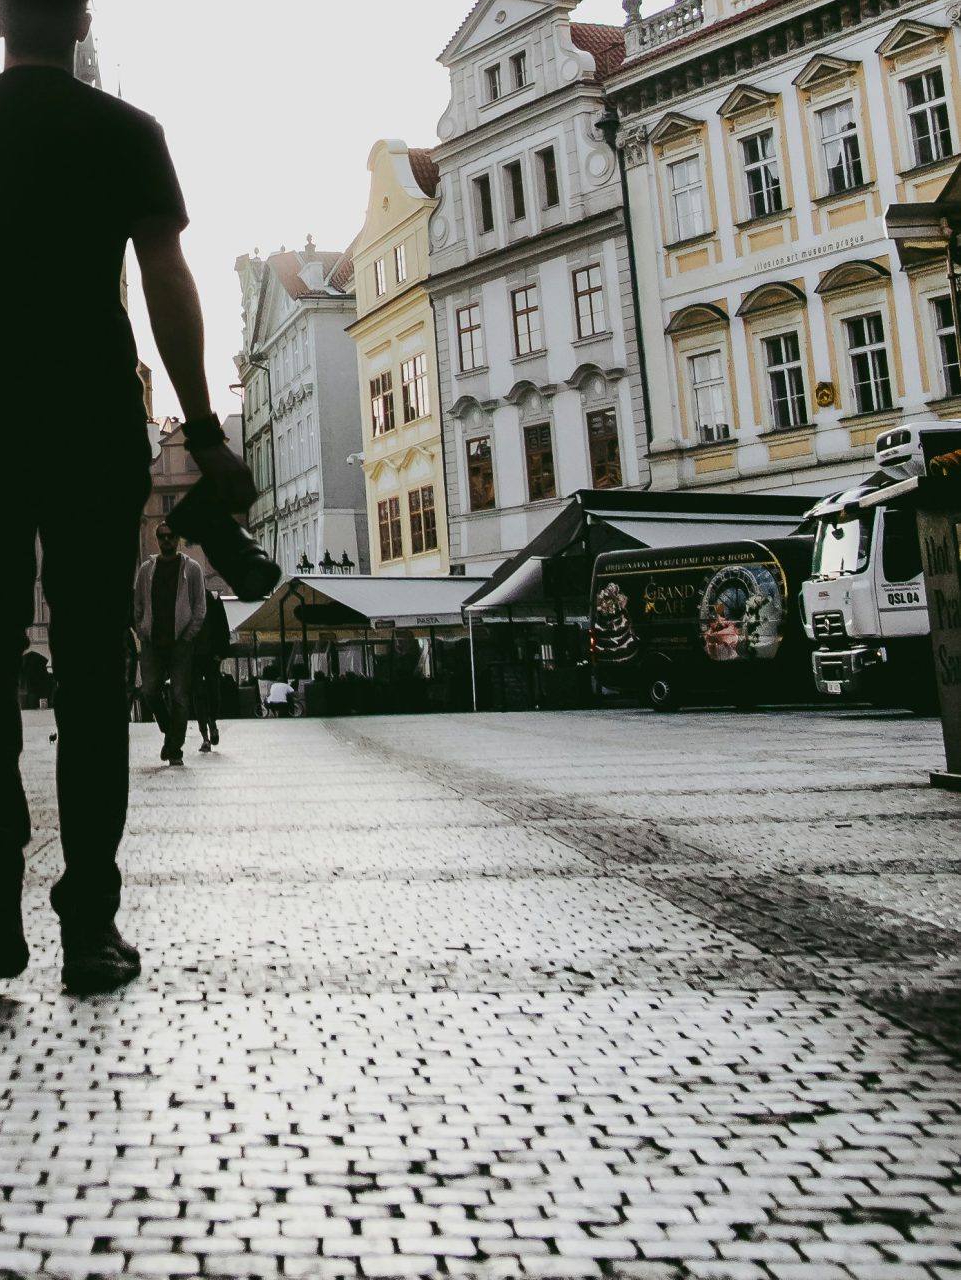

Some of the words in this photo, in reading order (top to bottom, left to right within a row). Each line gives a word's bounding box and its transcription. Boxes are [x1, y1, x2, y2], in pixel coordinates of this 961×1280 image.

[754, 258, 785, 271] illusion
[786, 254, 799, 262] art
[801, 243, 834, 258] museum
[835, 234, 865, 249] prague
[924, 535, 953, 578] Hot
[644, 582, 695, 600] GRAND
[887, 592, 906, 606] QSL
[416, 616, 440, 625] PASTA
